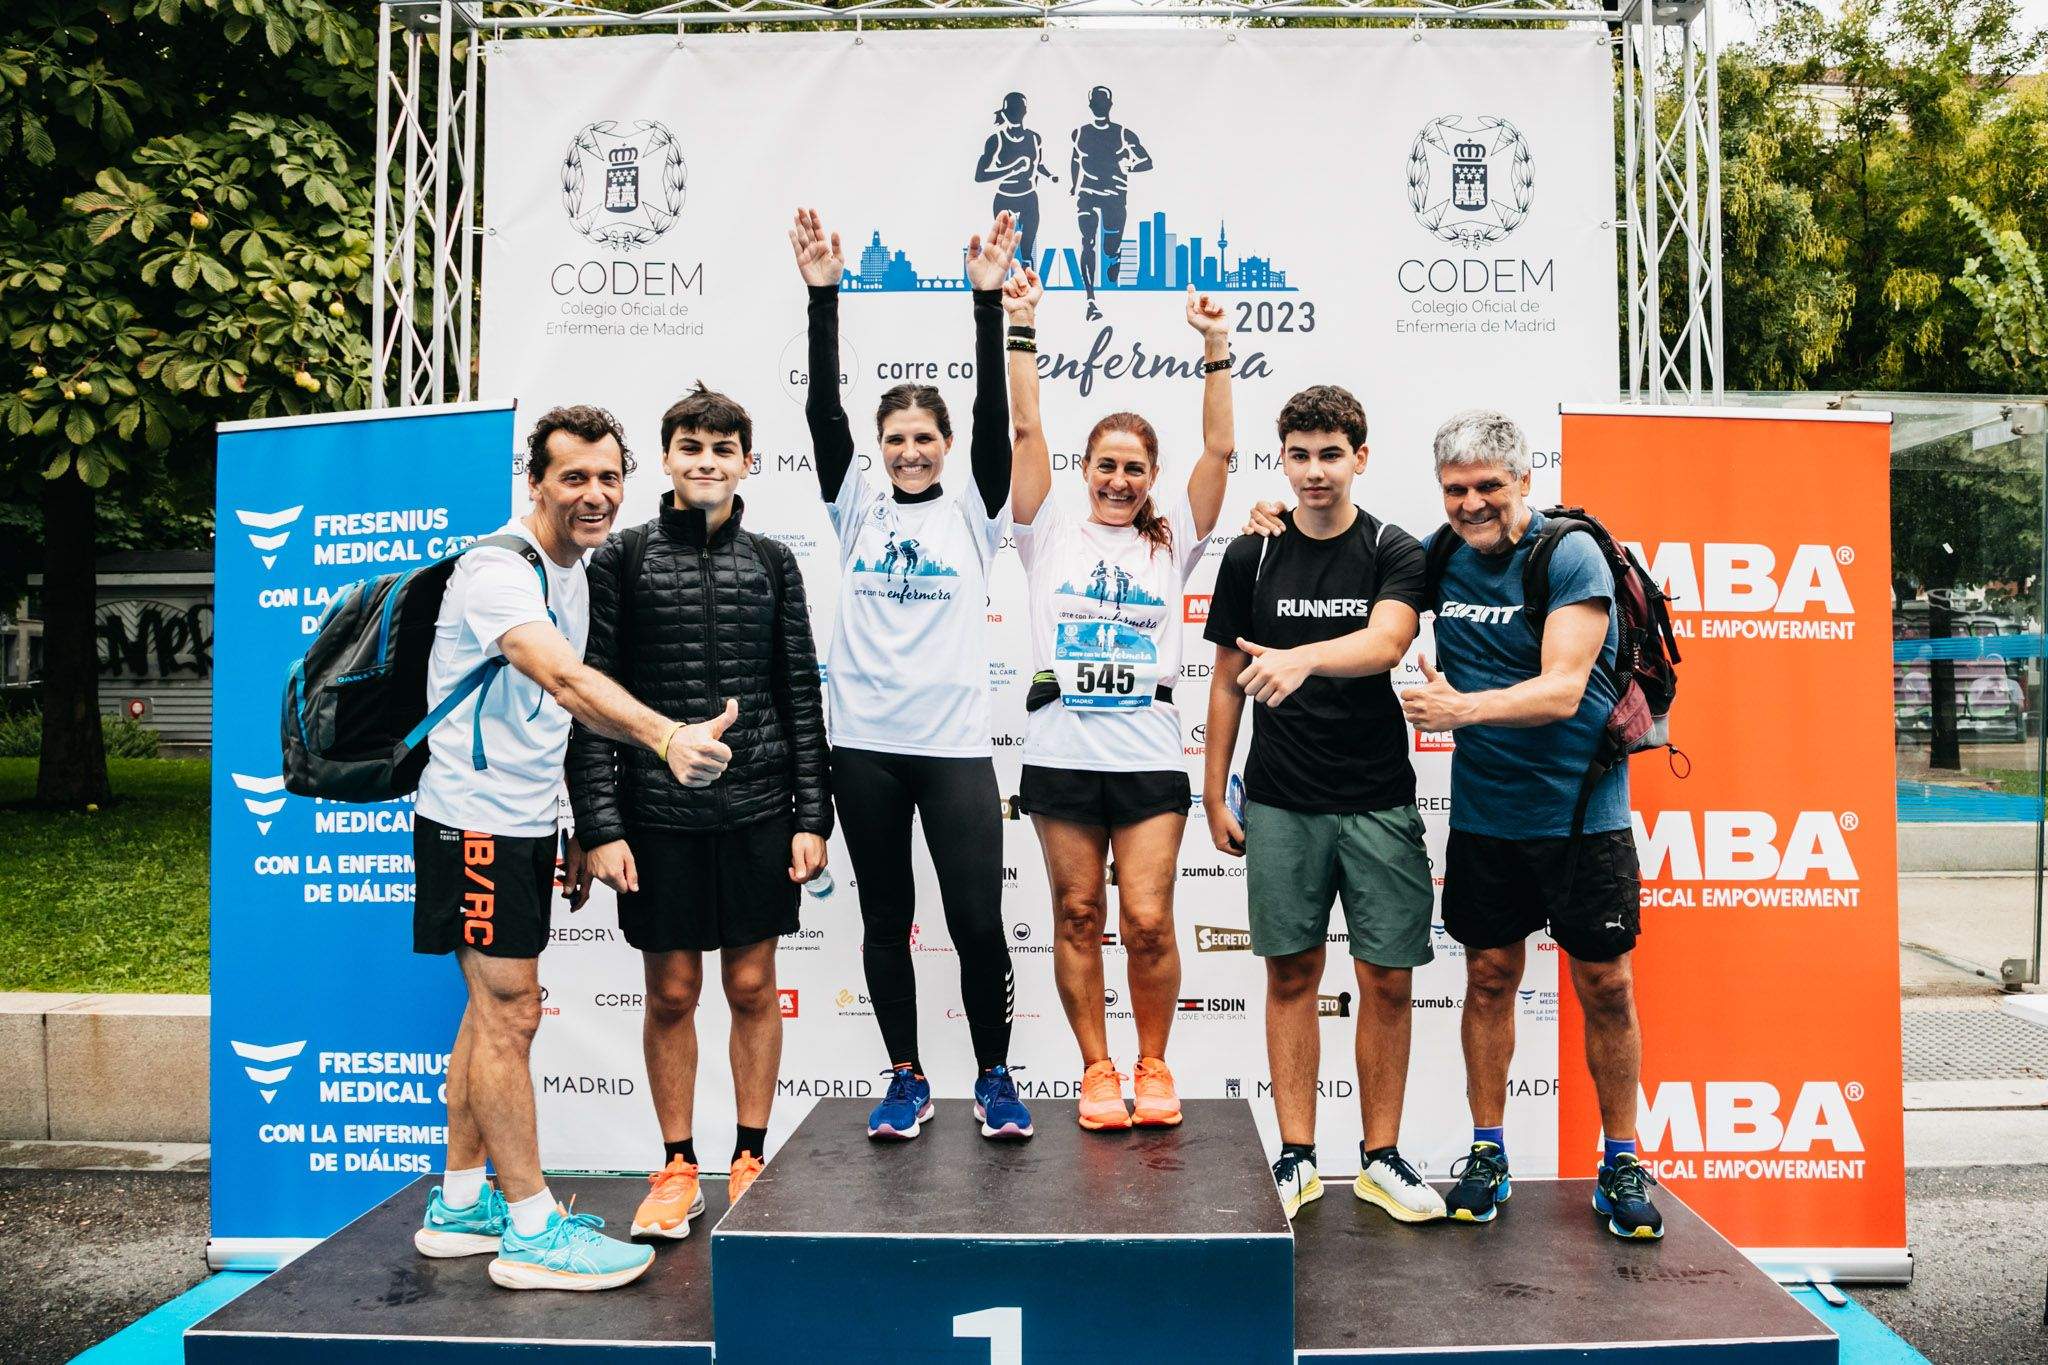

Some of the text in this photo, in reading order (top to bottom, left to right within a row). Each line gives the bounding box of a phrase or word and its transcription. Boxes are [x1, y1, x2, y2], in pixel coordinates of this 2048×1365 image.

[551, 261, 703, 296] CODEM
[1398, 258, 1555, 293] CODEM
[561, 301, 688, 318] Colegio Oficial de
[1236, 301, 1316, 333] 2023
[1411, 299, 1540, 317] Colegio Oficial de
[634, 321, 649, 335] de
[653, 321, 704, 335] Madrid
[1481, 319, 1500, 333] de
[1504, 318, 1556, 333] Madrid
[877, 362, 974, 380] corre co
[314, 507, 449, 537] FRESENIUS
[314, 535, 482, 566] MEDICAL CAR
[259, 586, 330, 609] CON LA
[887, 584, 952, 604] enfermera
[1439, 600, 1525, 624] GIANT
[301, 615, 322, 635] D
[1702, 619, 1855, 640] EMPOWERMENT
[1076, 662, 1136, 694] 545
[254, 854, 416, 875] CON LA ENFERM
[304, 884, 333, 903] DE
[1638, 887, 1860, 908] GICAL EMPOWERMENT
[1198, 927, 1251, 950] SECRETO
[1207, 998, 1246, 1011] ISDIN
[1411, 996, 1464, 1008] zumub.c
[1202, 1012, 1226, 1021] YOUR
[1227, 1012, 1246, 1021] SKIN
[319, 1081, 432, 1104] MEDICAL
[543, 1075, 634, 1096] MADRID
[777, 1079, 872, 1098] MADRID
[1016, 1080, 1082, 1098] MADR
[1257, 1080, 1353, 1098] MRID
[259, 1124, 450, 1145] CON LA ENFERME
[309, 1148, 432, 1173] DE DIÁLISIS
[1703, 1159, 1866, 1180] EMPOWERMENT
[953, 1306, 1022, 1365] 1
